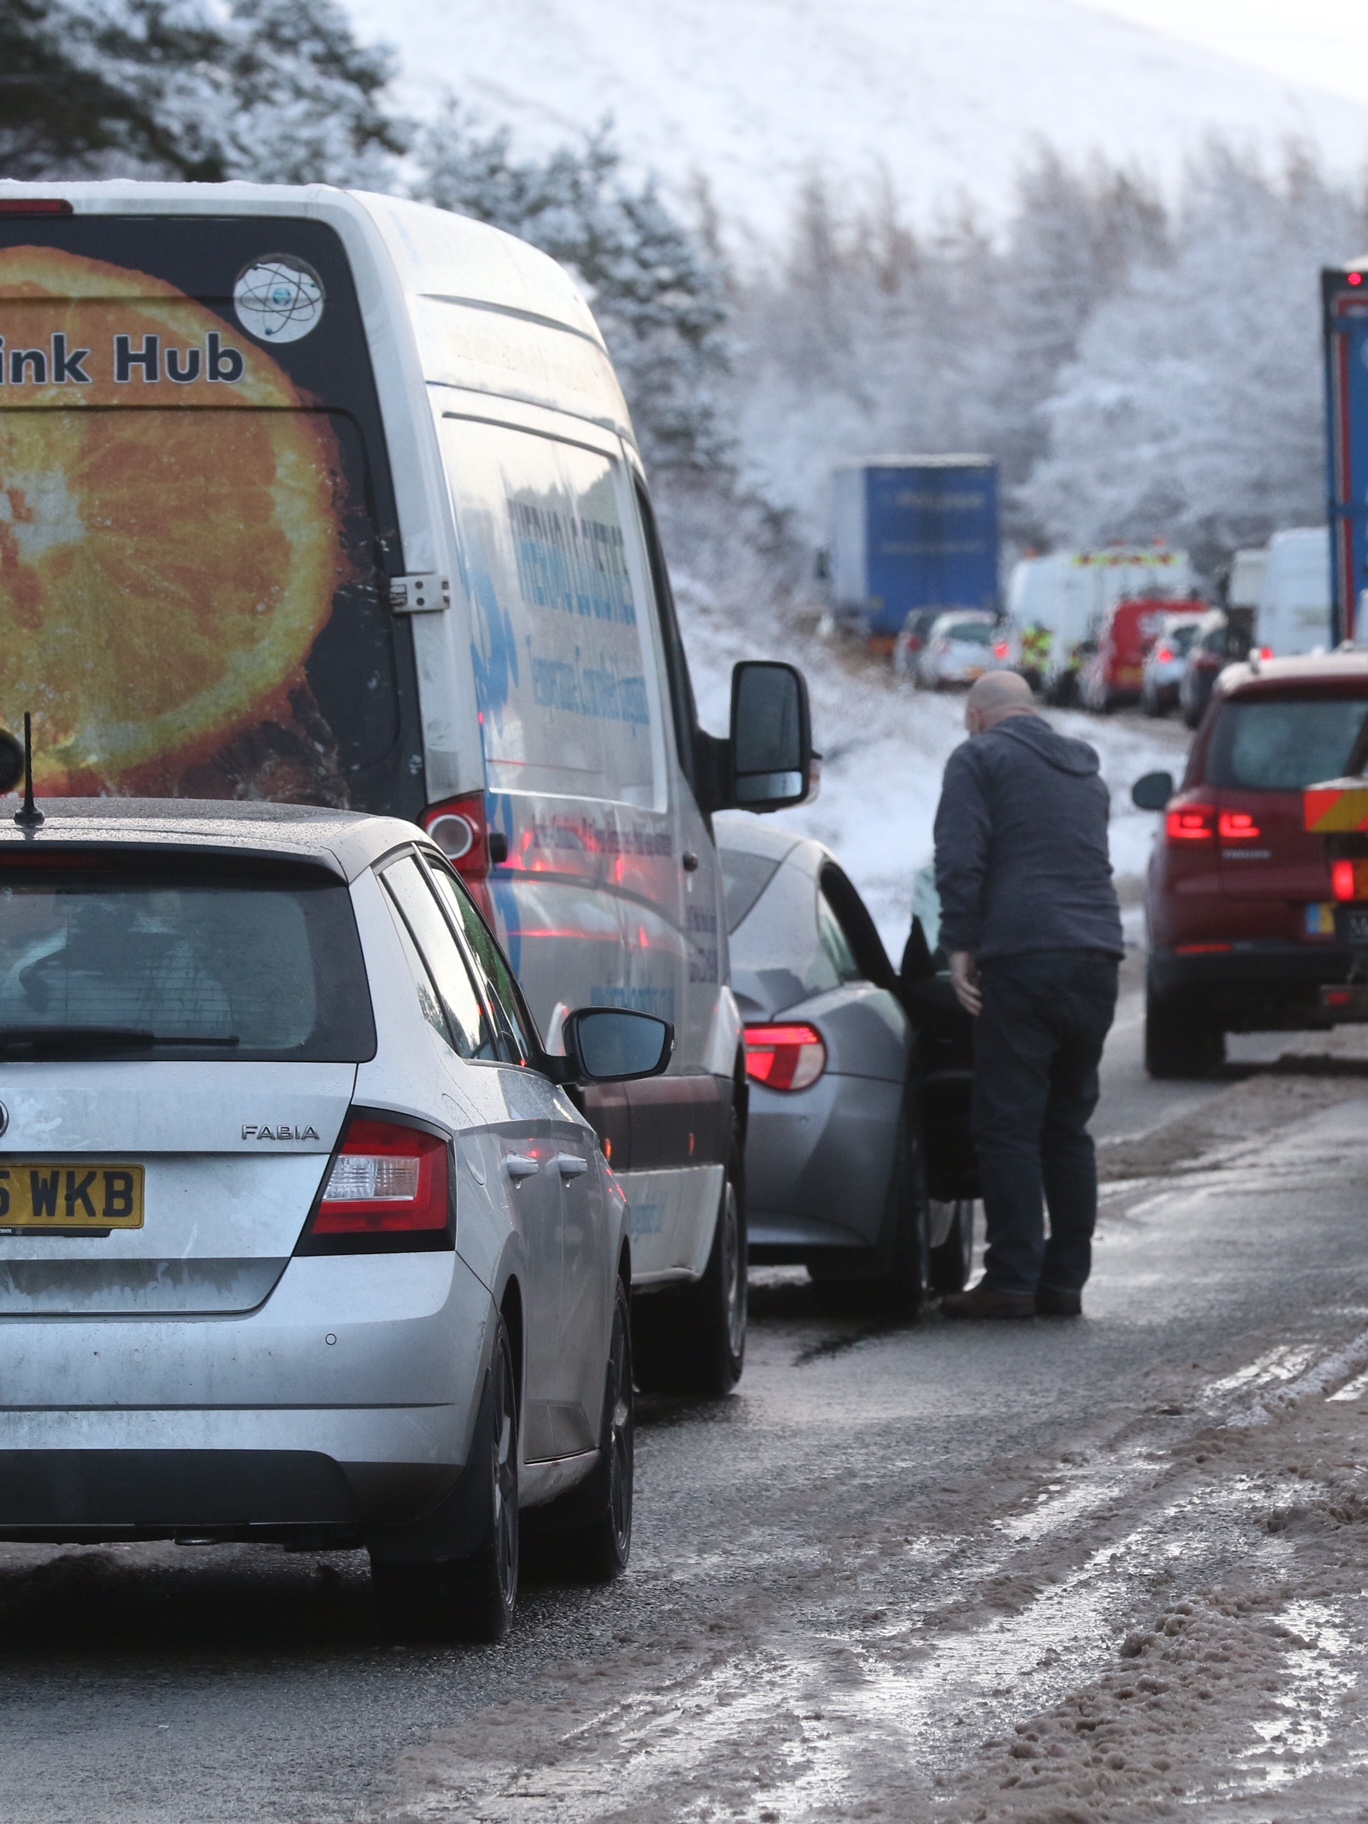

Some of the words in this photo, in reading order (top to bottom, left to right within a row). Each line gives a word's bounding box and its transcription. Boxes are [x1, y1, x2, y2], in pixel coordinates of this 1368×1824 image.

[0, 332, 92, 385] nk
[114, 331, 245, 384] Hub
[241, 1124, 320, 1141] FABIA
